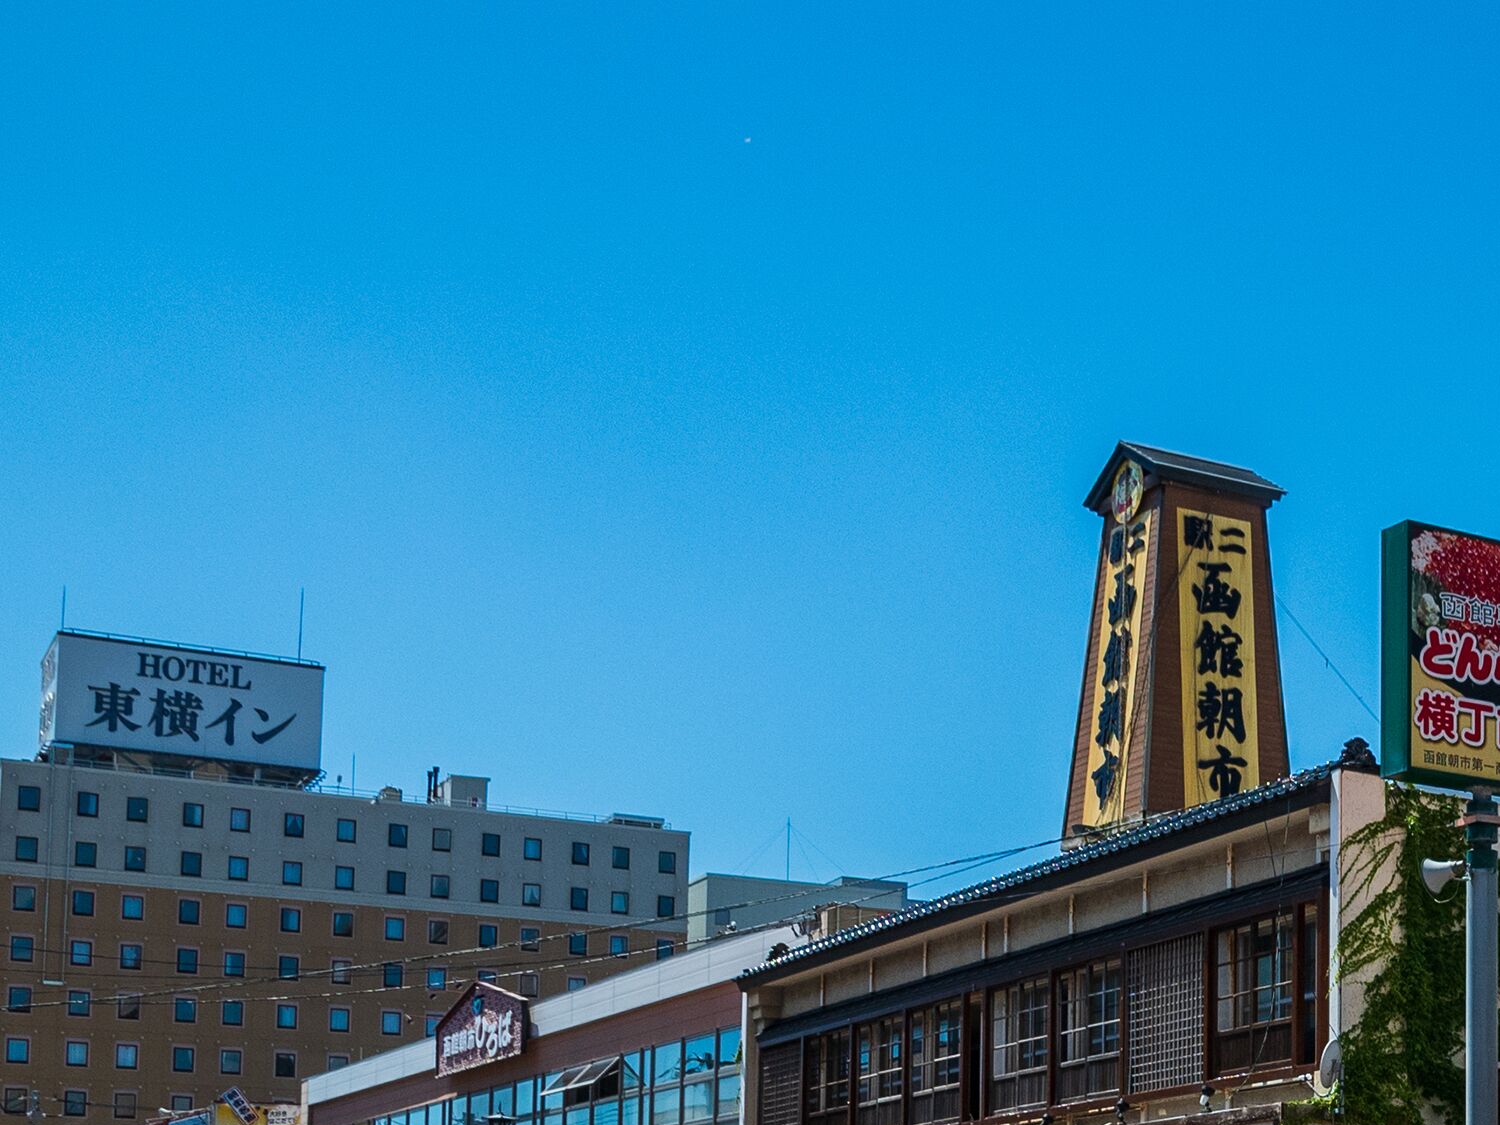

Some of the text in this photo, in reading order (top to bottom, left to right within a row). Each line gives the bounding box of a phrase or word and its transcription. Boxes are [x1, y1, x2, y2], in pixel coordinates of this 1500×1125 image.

[137, 652, 252, 690] HOTEL
[1192, 561, 1248, 799] 函館朝市
[85, 682, 297, 746] 東横イン
